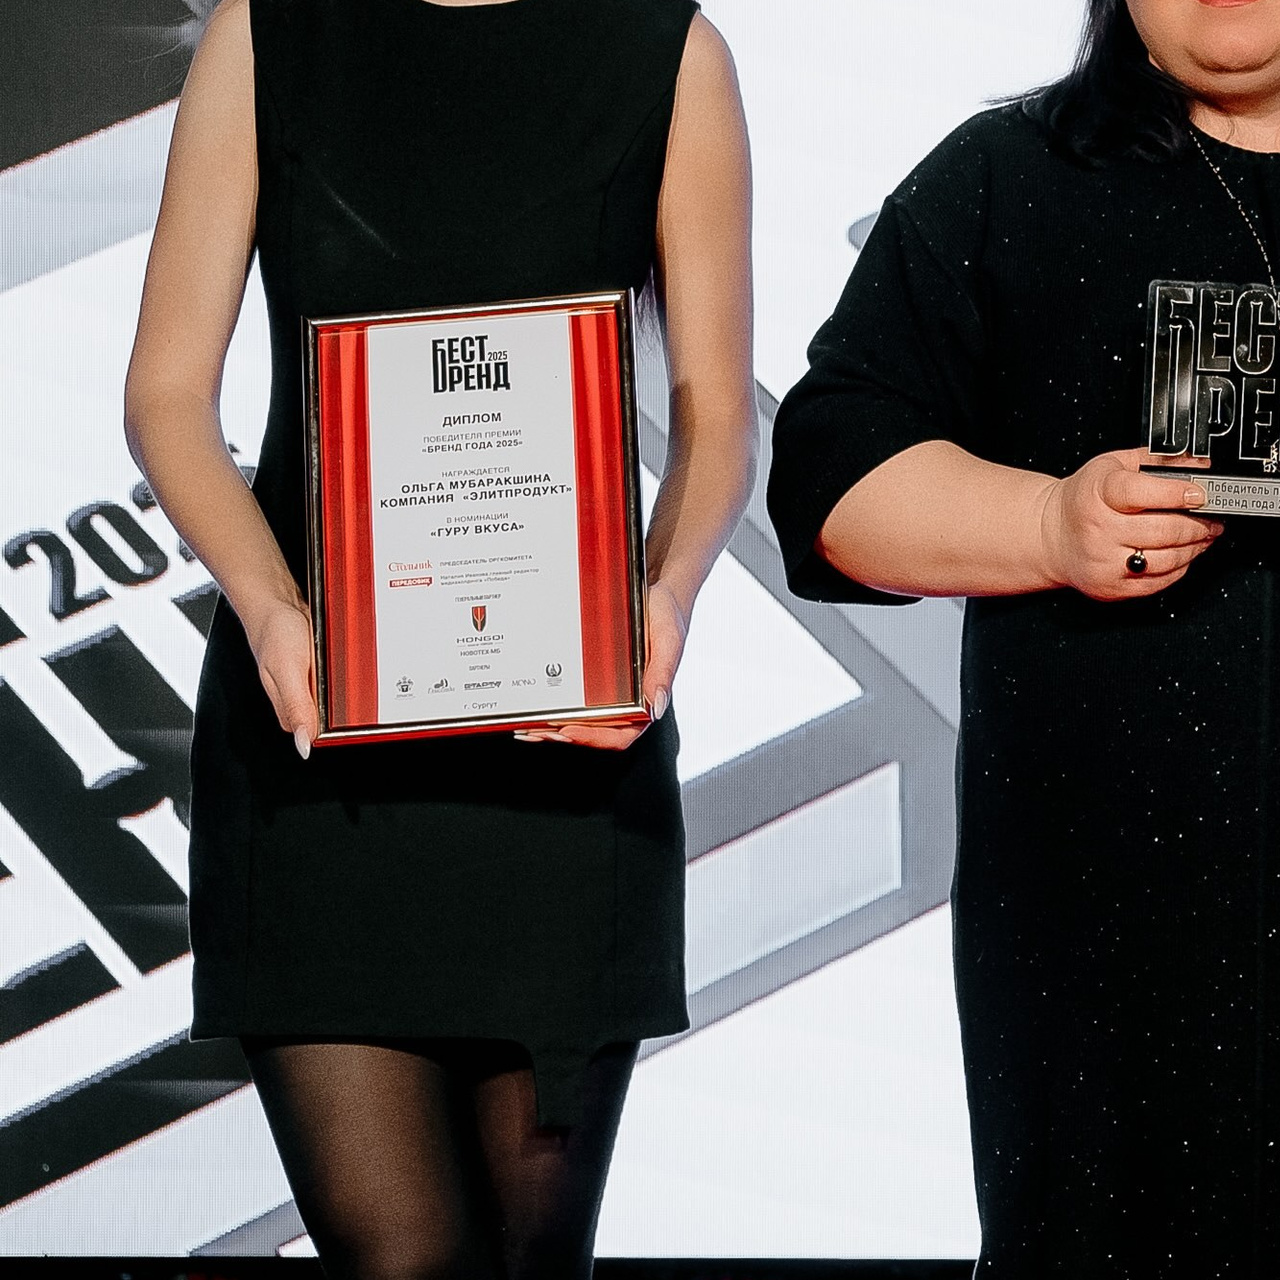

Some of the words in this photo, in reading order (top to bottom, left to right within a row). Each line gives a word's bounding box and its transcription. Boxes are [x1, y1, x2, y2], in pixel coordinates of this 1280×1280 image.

[487, 350, 508, 362] 2025
[442, 412, 502, 428] ДИПЛОМ
[423, 433, 482, 444] ПОБЕДИТЕЛЯ
[484, 429, 522, 438] ПРЕМИИ
[465, 441, 494, 451] ГОДА
[441, 466, 510, 478] НАГРАЖДАЕТСЯ
[401, 483, 445, 494] ОЛЬГА
[449, 473, 551, 490] МУБАРАКШИНА
[1208, 481, 1270, 496] Победитель
[380, 493, 454, 508] КОМПАНИЯ
[463, 484, 572, 501] «ЭЛИТПРОДУКТ»
[1208, 495, 1248, 509] «Бренд
[1251, 500, 1275, 510] года
[454, 513, 509, 523] НОМИНАЦИИ
[430, 526, 470, 537] «ГУРУ
[474, 522, 525, 534] ВКУСА»
[472, 701, 498, 710] Сургут
